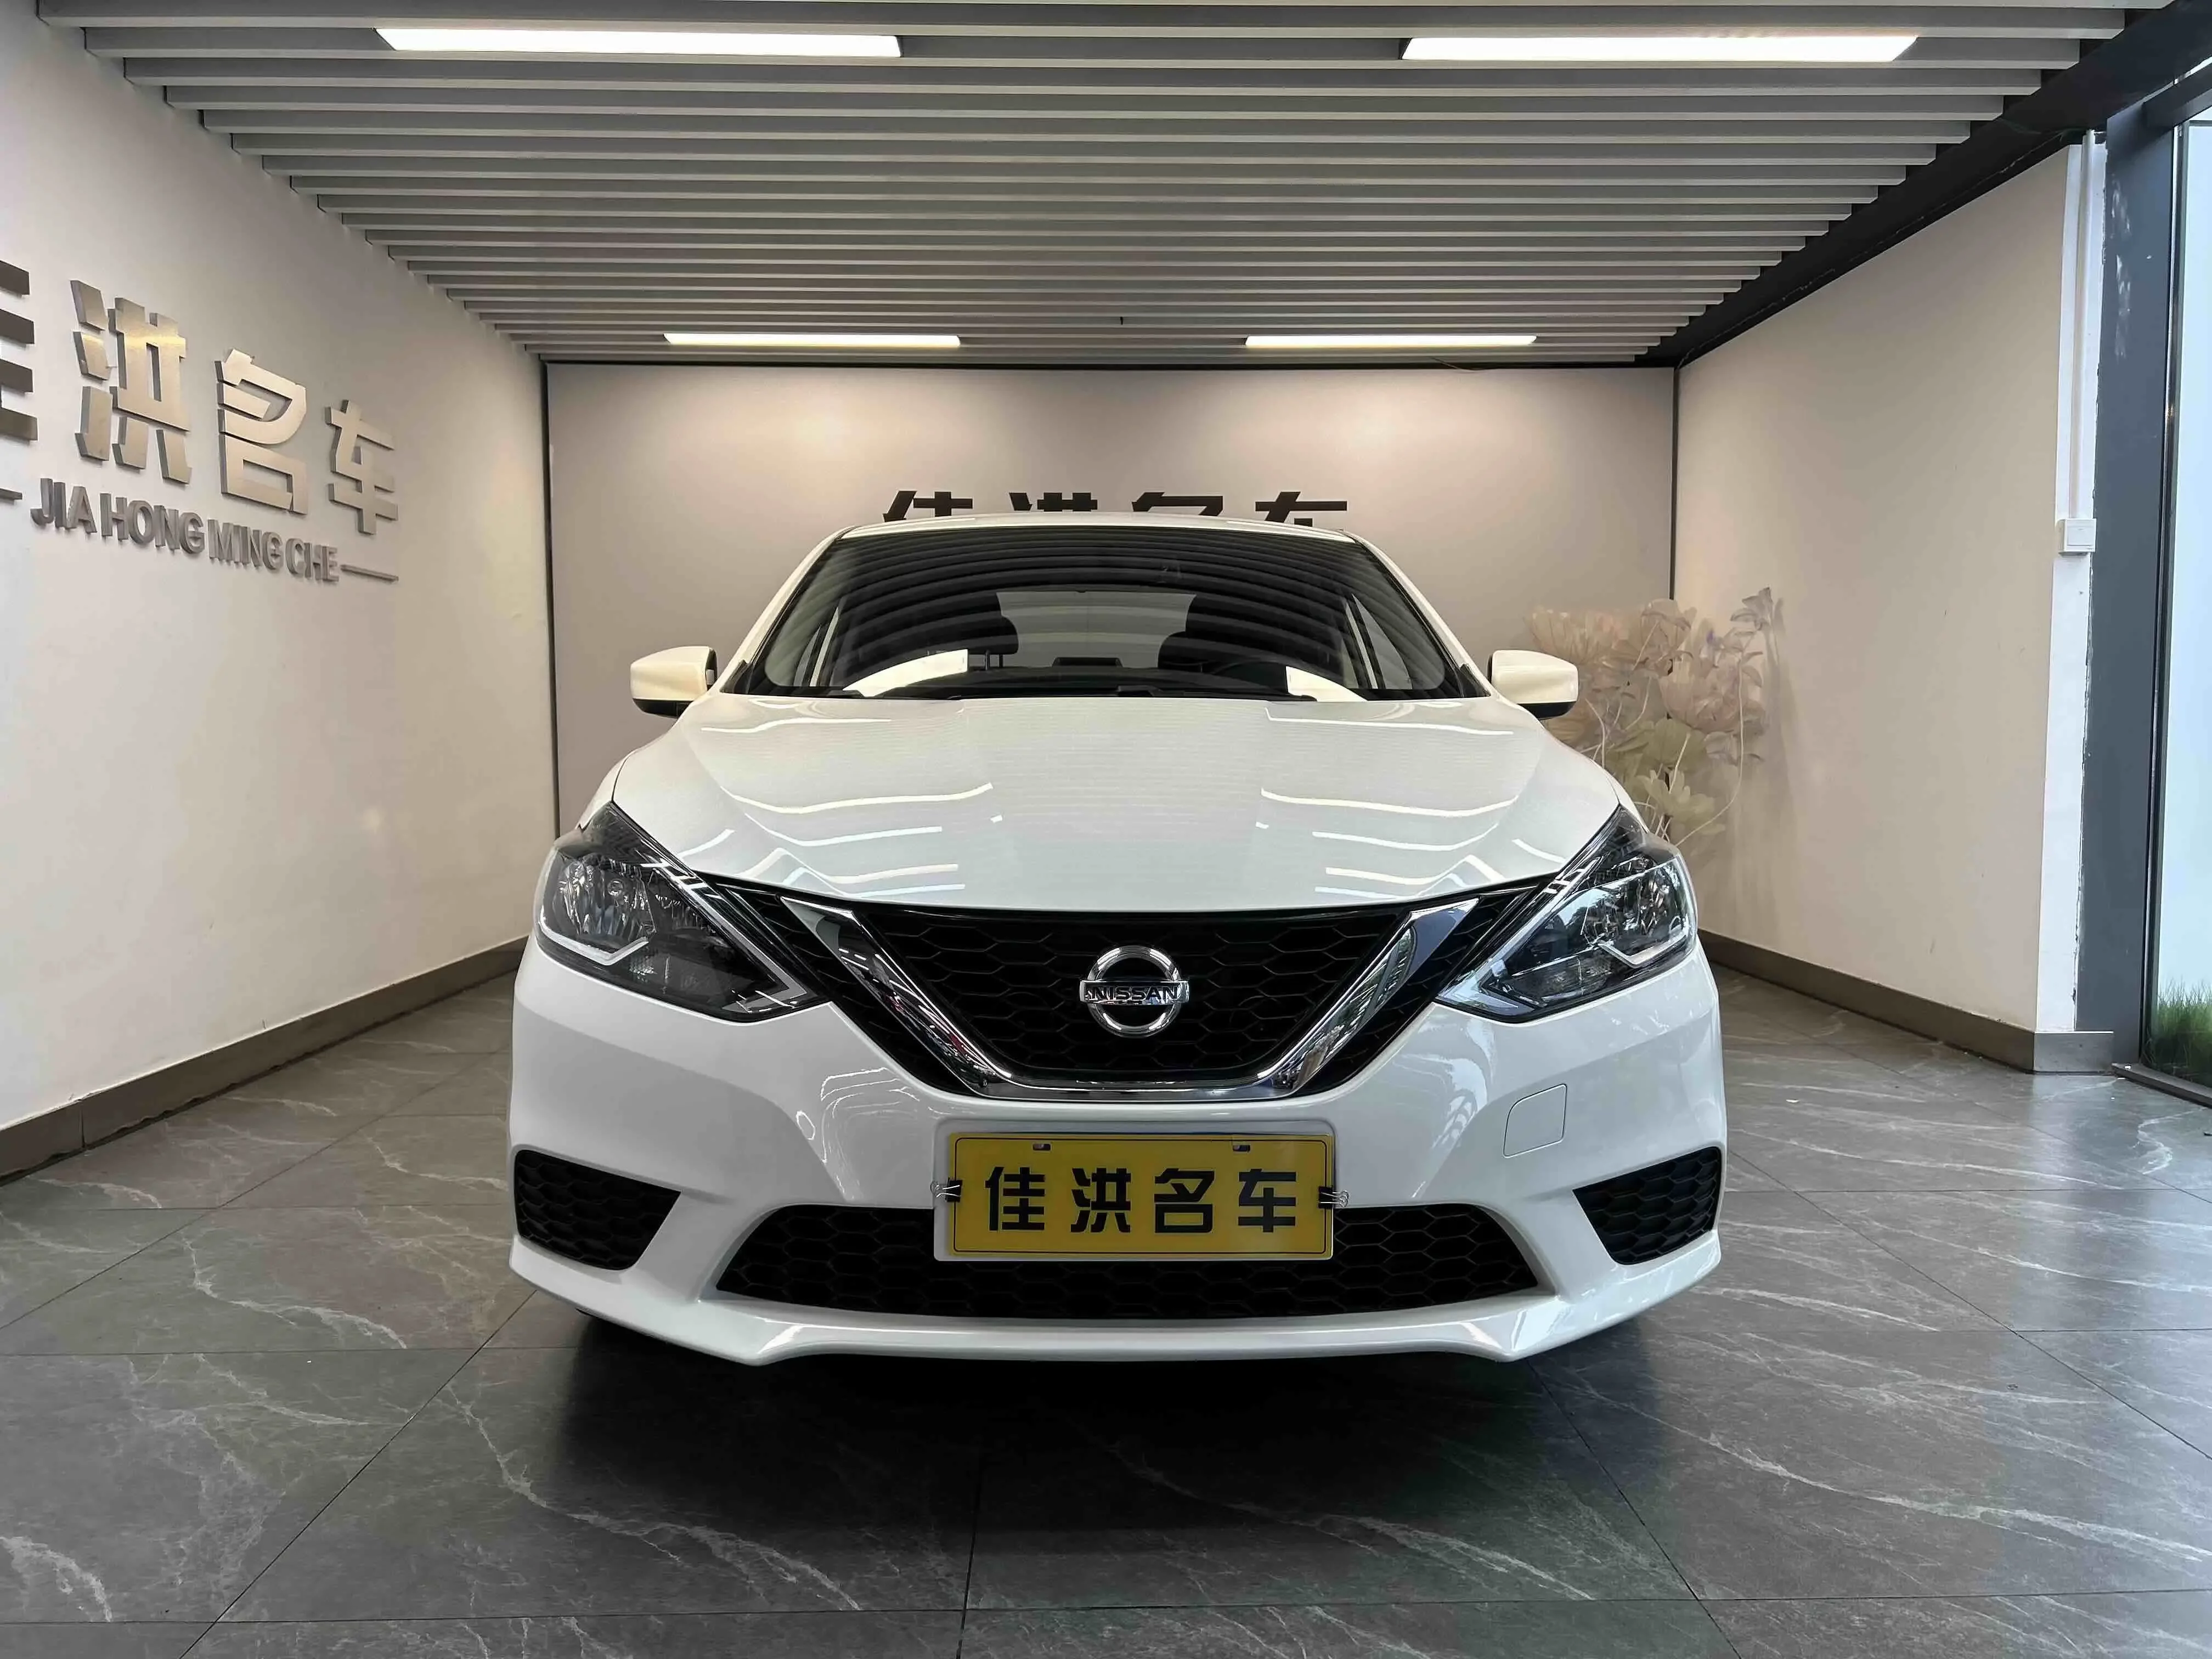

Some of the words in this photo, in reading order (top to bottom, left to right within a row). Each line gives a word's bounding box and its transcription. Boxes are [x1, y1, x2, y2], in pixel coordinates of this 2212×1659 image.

[30, 478, 97, 533] JIA
[100, 493, 205, 554] HONG
[207, 519, 285, 571] MING
[285, 538, 339, 583] CHE
[1092, 986, 1178, 1001] NISSAN
[985, 1166, 1297, 1233] 佳洪名车
